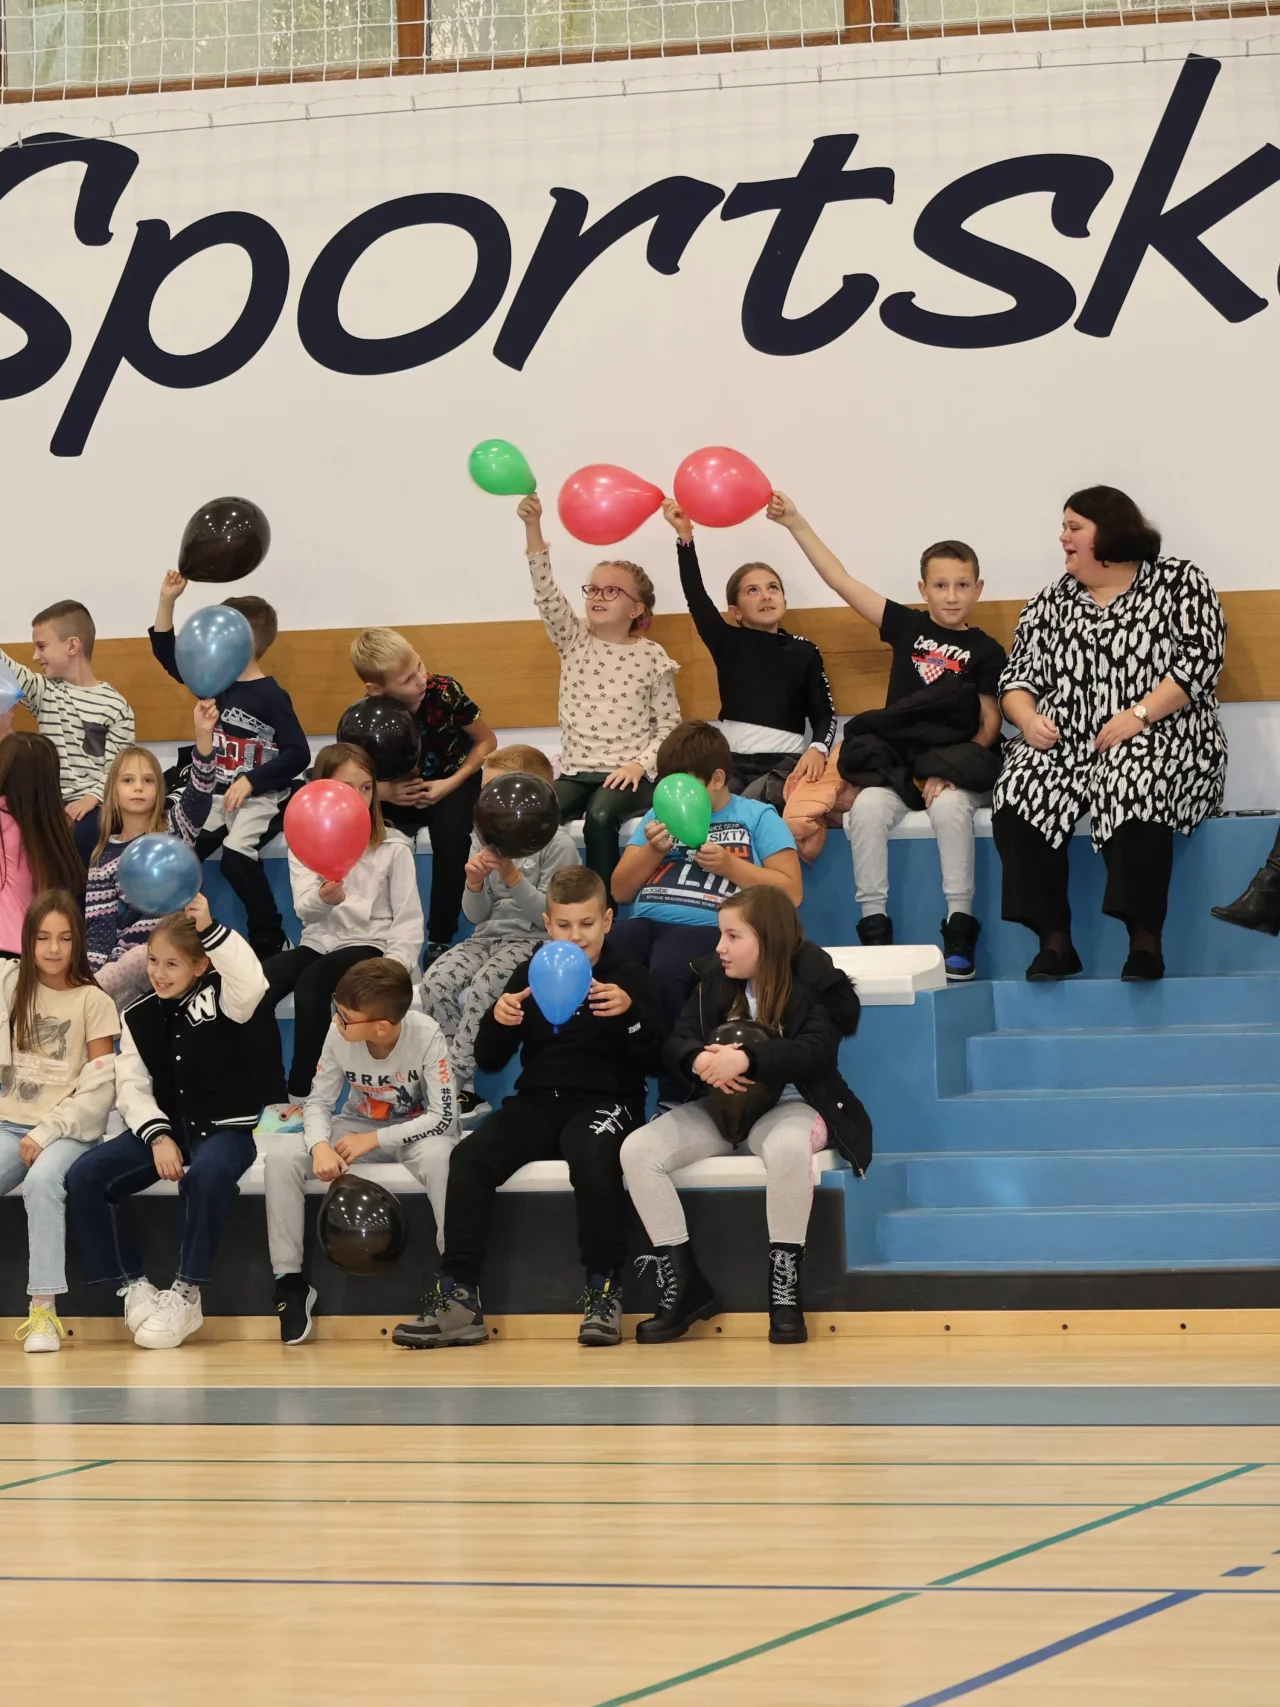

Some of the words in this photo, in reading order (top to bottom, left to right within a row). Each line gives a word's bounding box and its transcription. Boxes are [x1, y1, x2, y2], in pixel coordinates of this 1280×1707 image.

[913, 635, 971, 665] CROATIA
[709, 831, 746, 843] SIXTY
[185, 985, 217, 1027] W
[627, 1021, 641, 1034] NIKE
[438, 1059, 450, 1084] NYC
